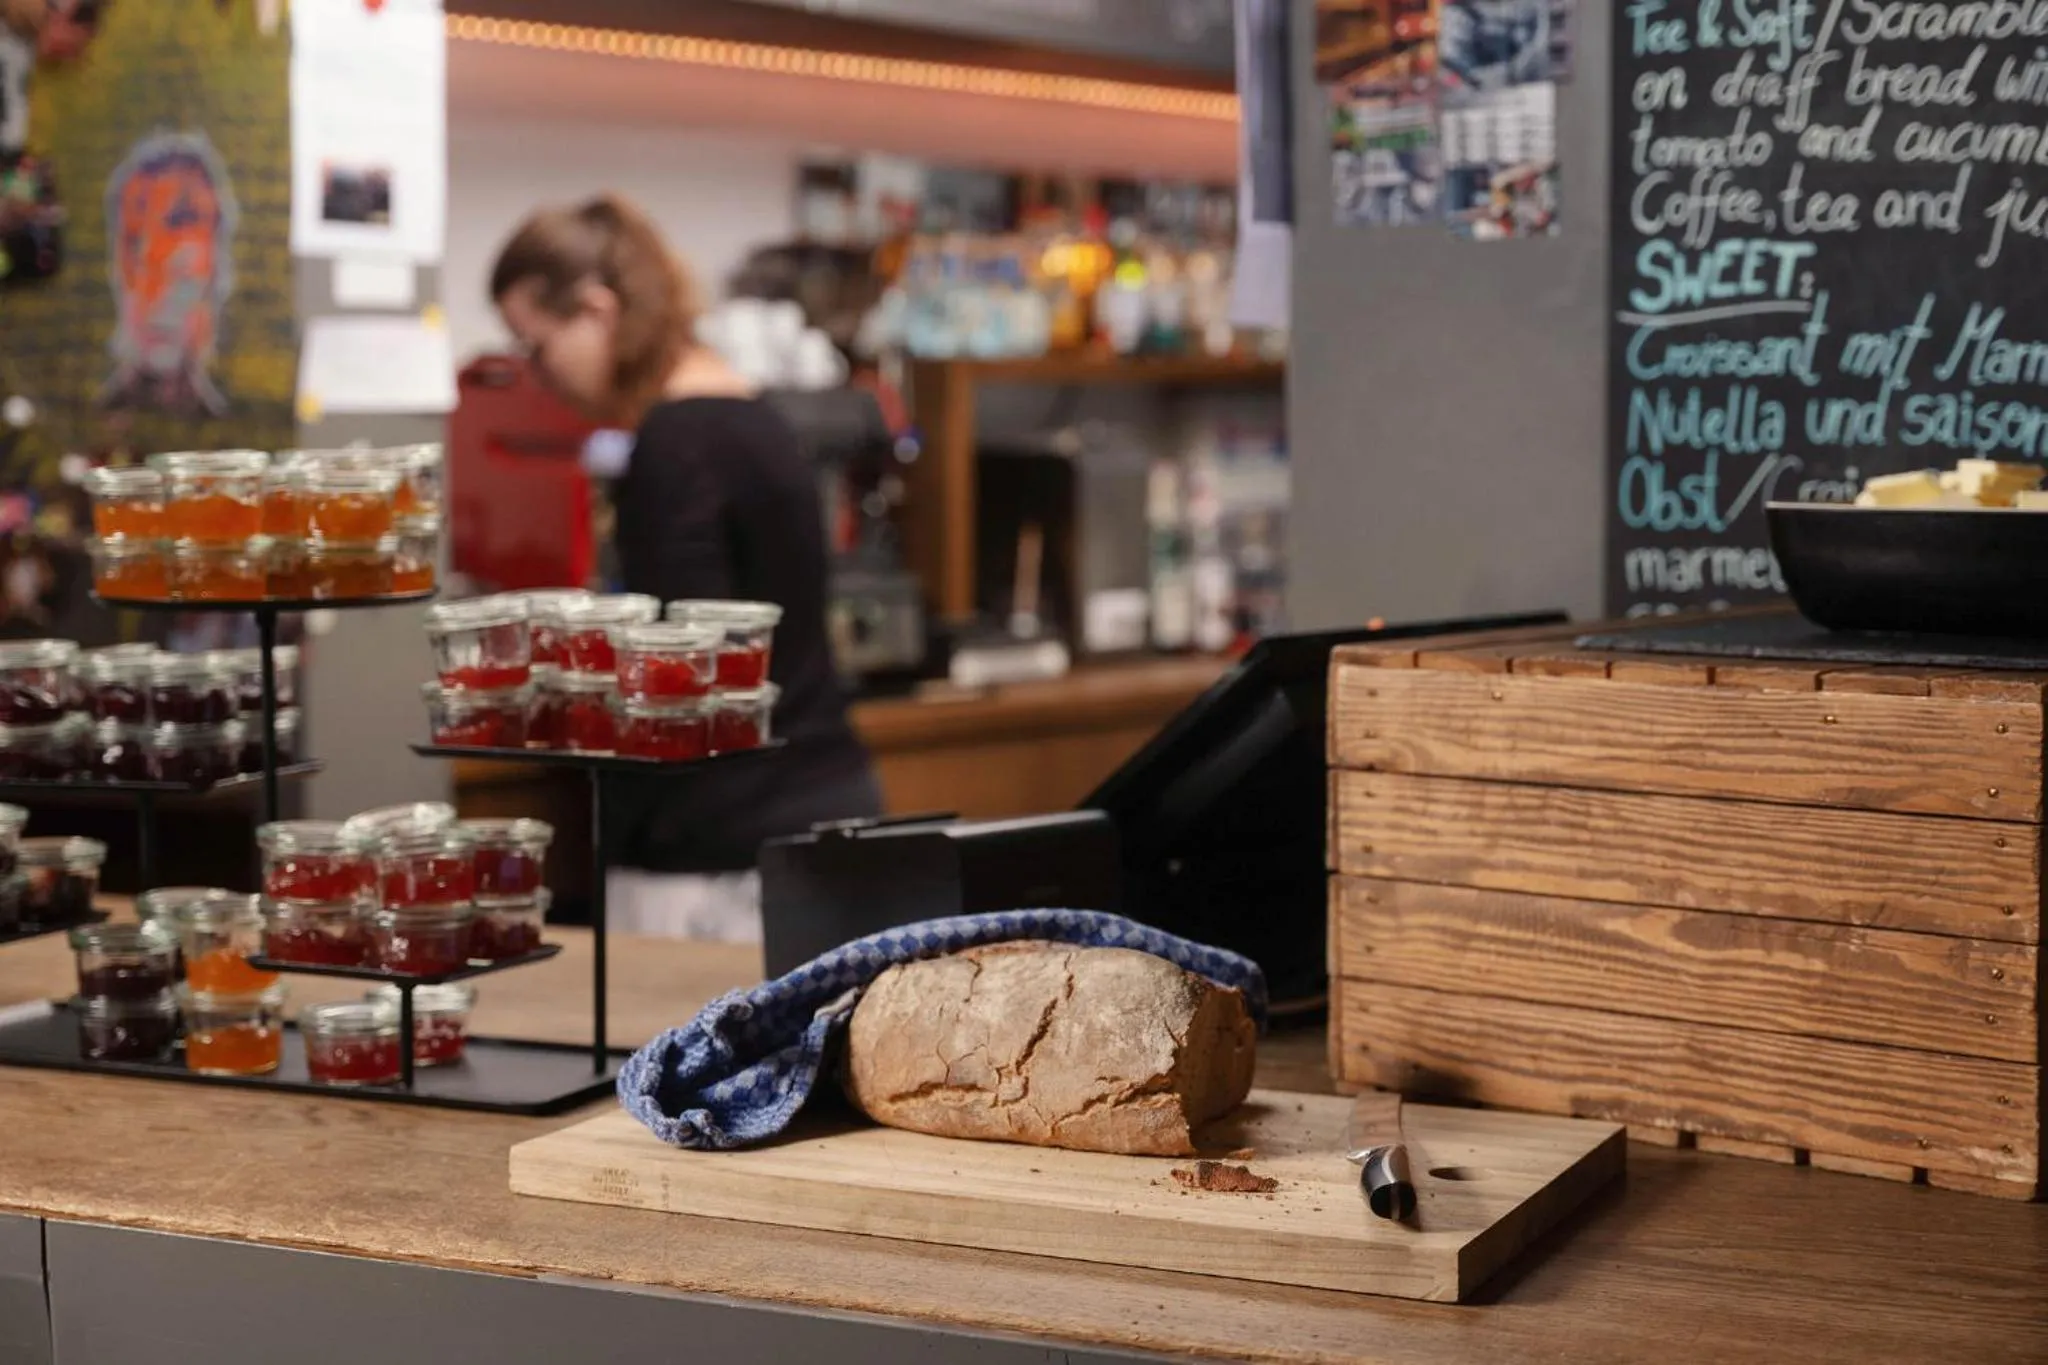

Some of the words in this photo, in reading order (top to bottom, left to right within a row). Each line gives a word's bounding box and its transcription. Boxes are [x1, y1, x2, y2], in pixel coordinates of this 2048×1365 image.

[1625, 0, 1690, 57] Tee
[1632, 66, 1688, 112] on
[1845, 43, 1987, 106] bread
[1798, 101, 1883, 161] and
[1873, 162, 1974, 234] and
[1975, 176, 2048, 268] ju
[1629, 239, 1818, 313] SWEET:
[1626, 290, 1829, 386] Croissant
[1838, 292, 1936, 390] mit
[1626, 384, 1786, 455] Nutella
[1805, 378, 1893, 448] und
[1618, 446, 1727, 533] Obst
